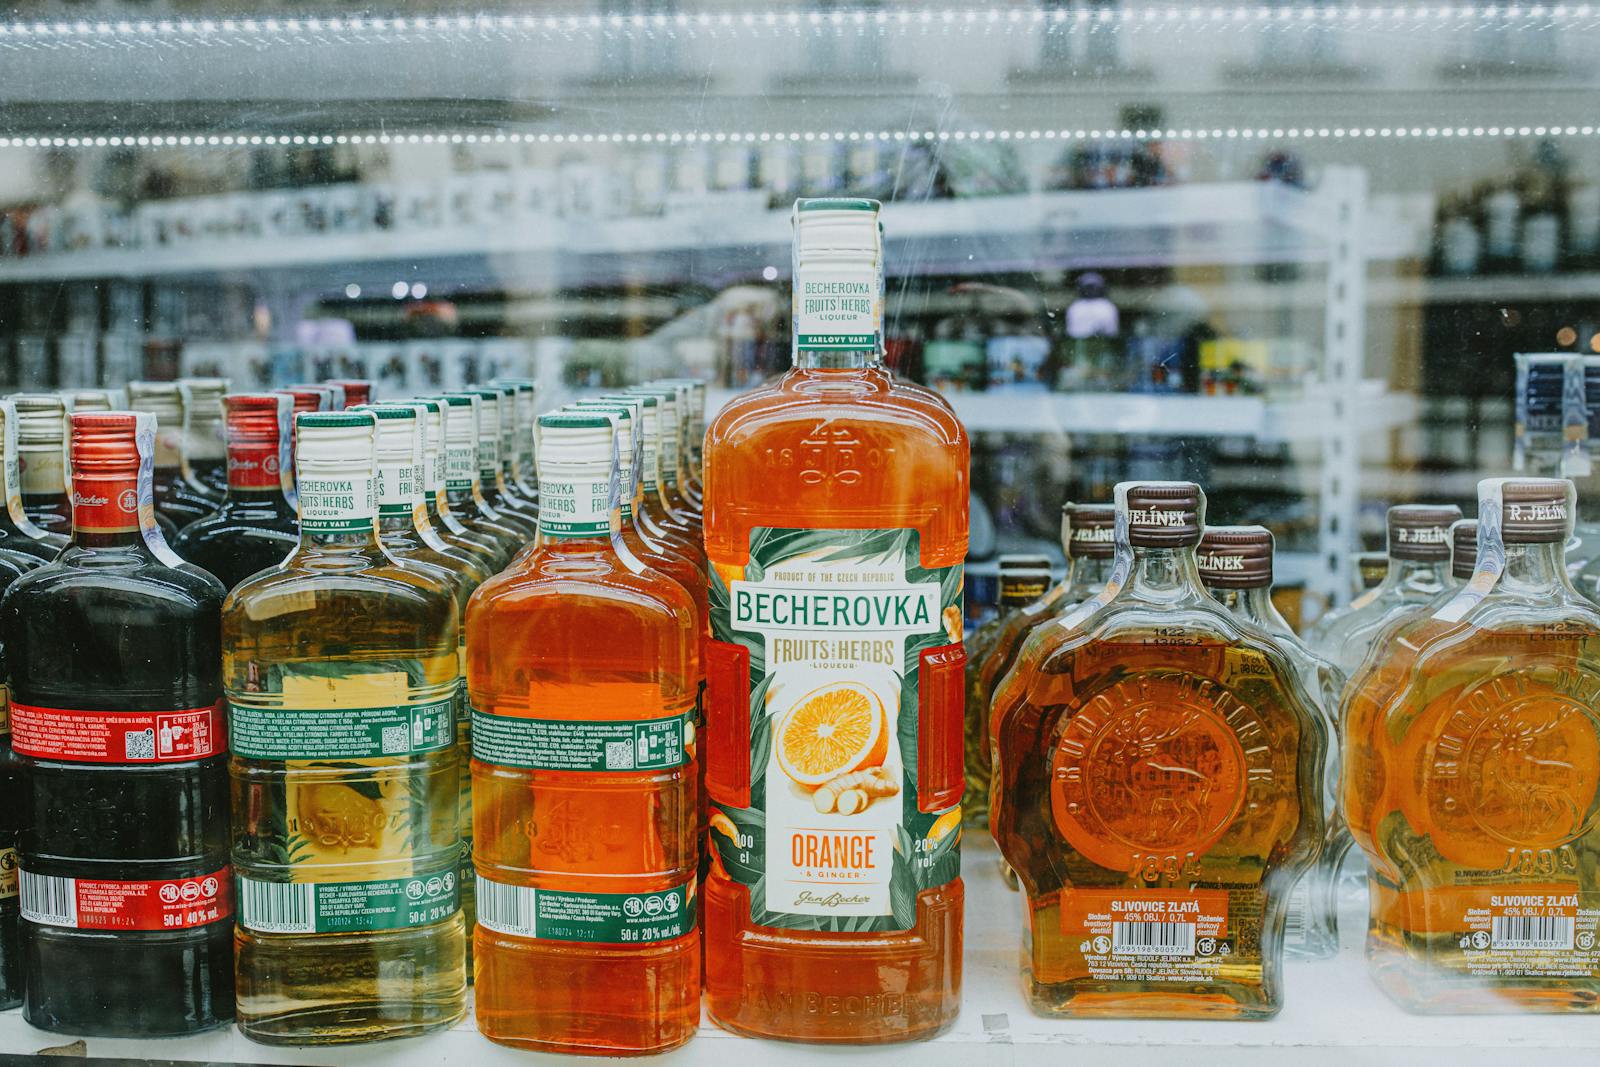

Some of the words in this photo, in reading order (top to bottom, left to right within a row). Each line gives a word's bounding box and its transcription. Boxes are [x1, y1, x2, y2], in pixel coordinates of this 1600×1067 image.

[805, 282, 870, 294] BECHEROVKA
[805, 299, 836, 315] FRUITS
[841, 299, 870, 315] HERBS
[301, 481, 352, 492] ECHEROVKA
[323, 496, 354, 510] HERBS
[548, 498, 576, 513] HERBS
[774, 572, 803, 581] PRODUCT
[808, 572, 816, 582] OF
[821, 573, 832, 582] THE
[837, 573, 858, 582] CZECH
[737, 590, 930, 626] BECHEROVKA
[1153, 628, 1185, 637] 1422
[774, 639, 829, 664] FRUITS
[838, 639, 894, 665] HERBS
[173, 715, 200, 724] ENERGY
[650, 723, 673, 732] ENERGY
[736, 834, 754, 849] 100
[915, 838, 938, 853] 20%
[792, 833, 876, 869] ORANGE
[740, 852, 750, 864] cl
[917, 856, 936, 869] vol.
[1111, 901, 1165, 913] SLIVOVICE
[1167, 900, 1200, 913] ZLATÁ
[1491, 896, 1544, 906] SLIVOVICE
[1547, 894, 1578, 907] ZLATÁ
[164, 914, 174, 926] 50
[175, 914, 182, 925] cl
[187, 911, 198, 923] 40
[410, 912, 419, 924] 50
[420, 910, 427, 922] cl
[431, 908, 439, 920] 20
[1124, 914, 1141, 922] 45%
[1143, 914, 1160, 922] OBJ.
[1503, 908, 1520, 916] 45%
[621, 929, 631, 940] 50
[632, 929, 638, 941] cl
[642, 928, 652, 940] 20
